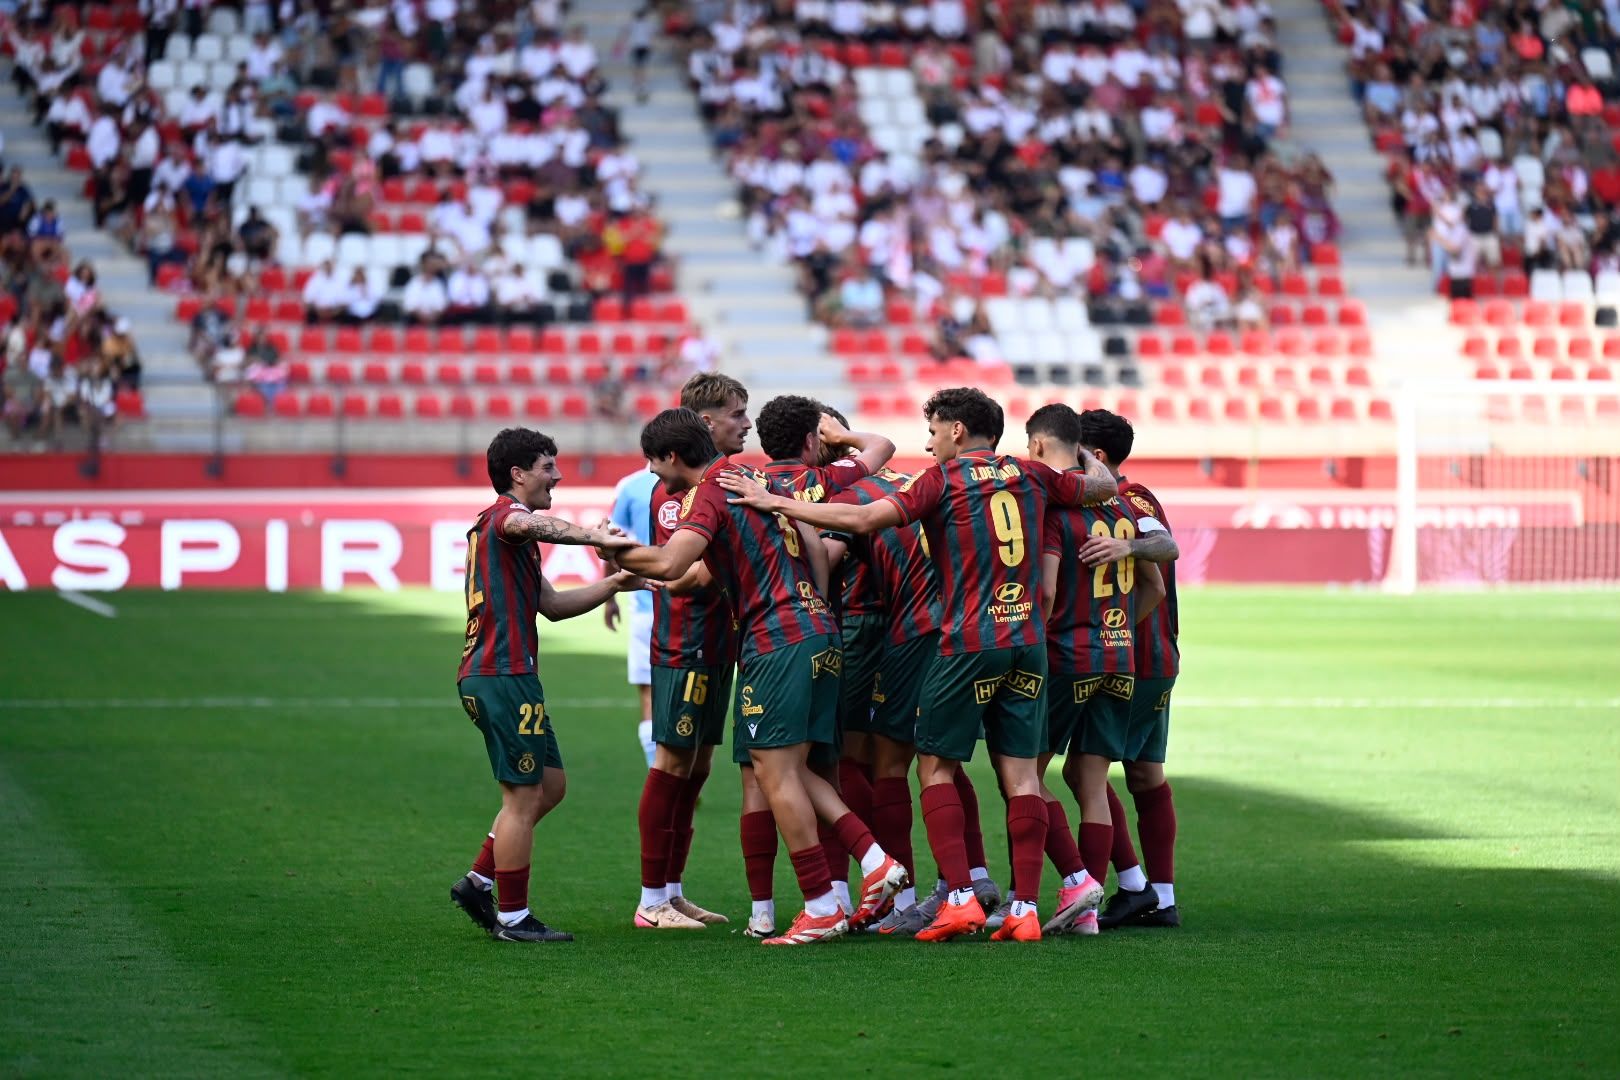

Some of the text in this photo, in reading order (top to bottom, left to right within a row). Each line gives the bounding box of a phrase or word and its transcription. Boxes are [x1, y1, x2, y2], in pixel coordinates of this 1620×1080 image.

[990, 491, 1024, 567] 9
[1091, 518, 1135, 598] 20
[683, 671, 709, 705] 15
[518, 703, 544, 735] 22
